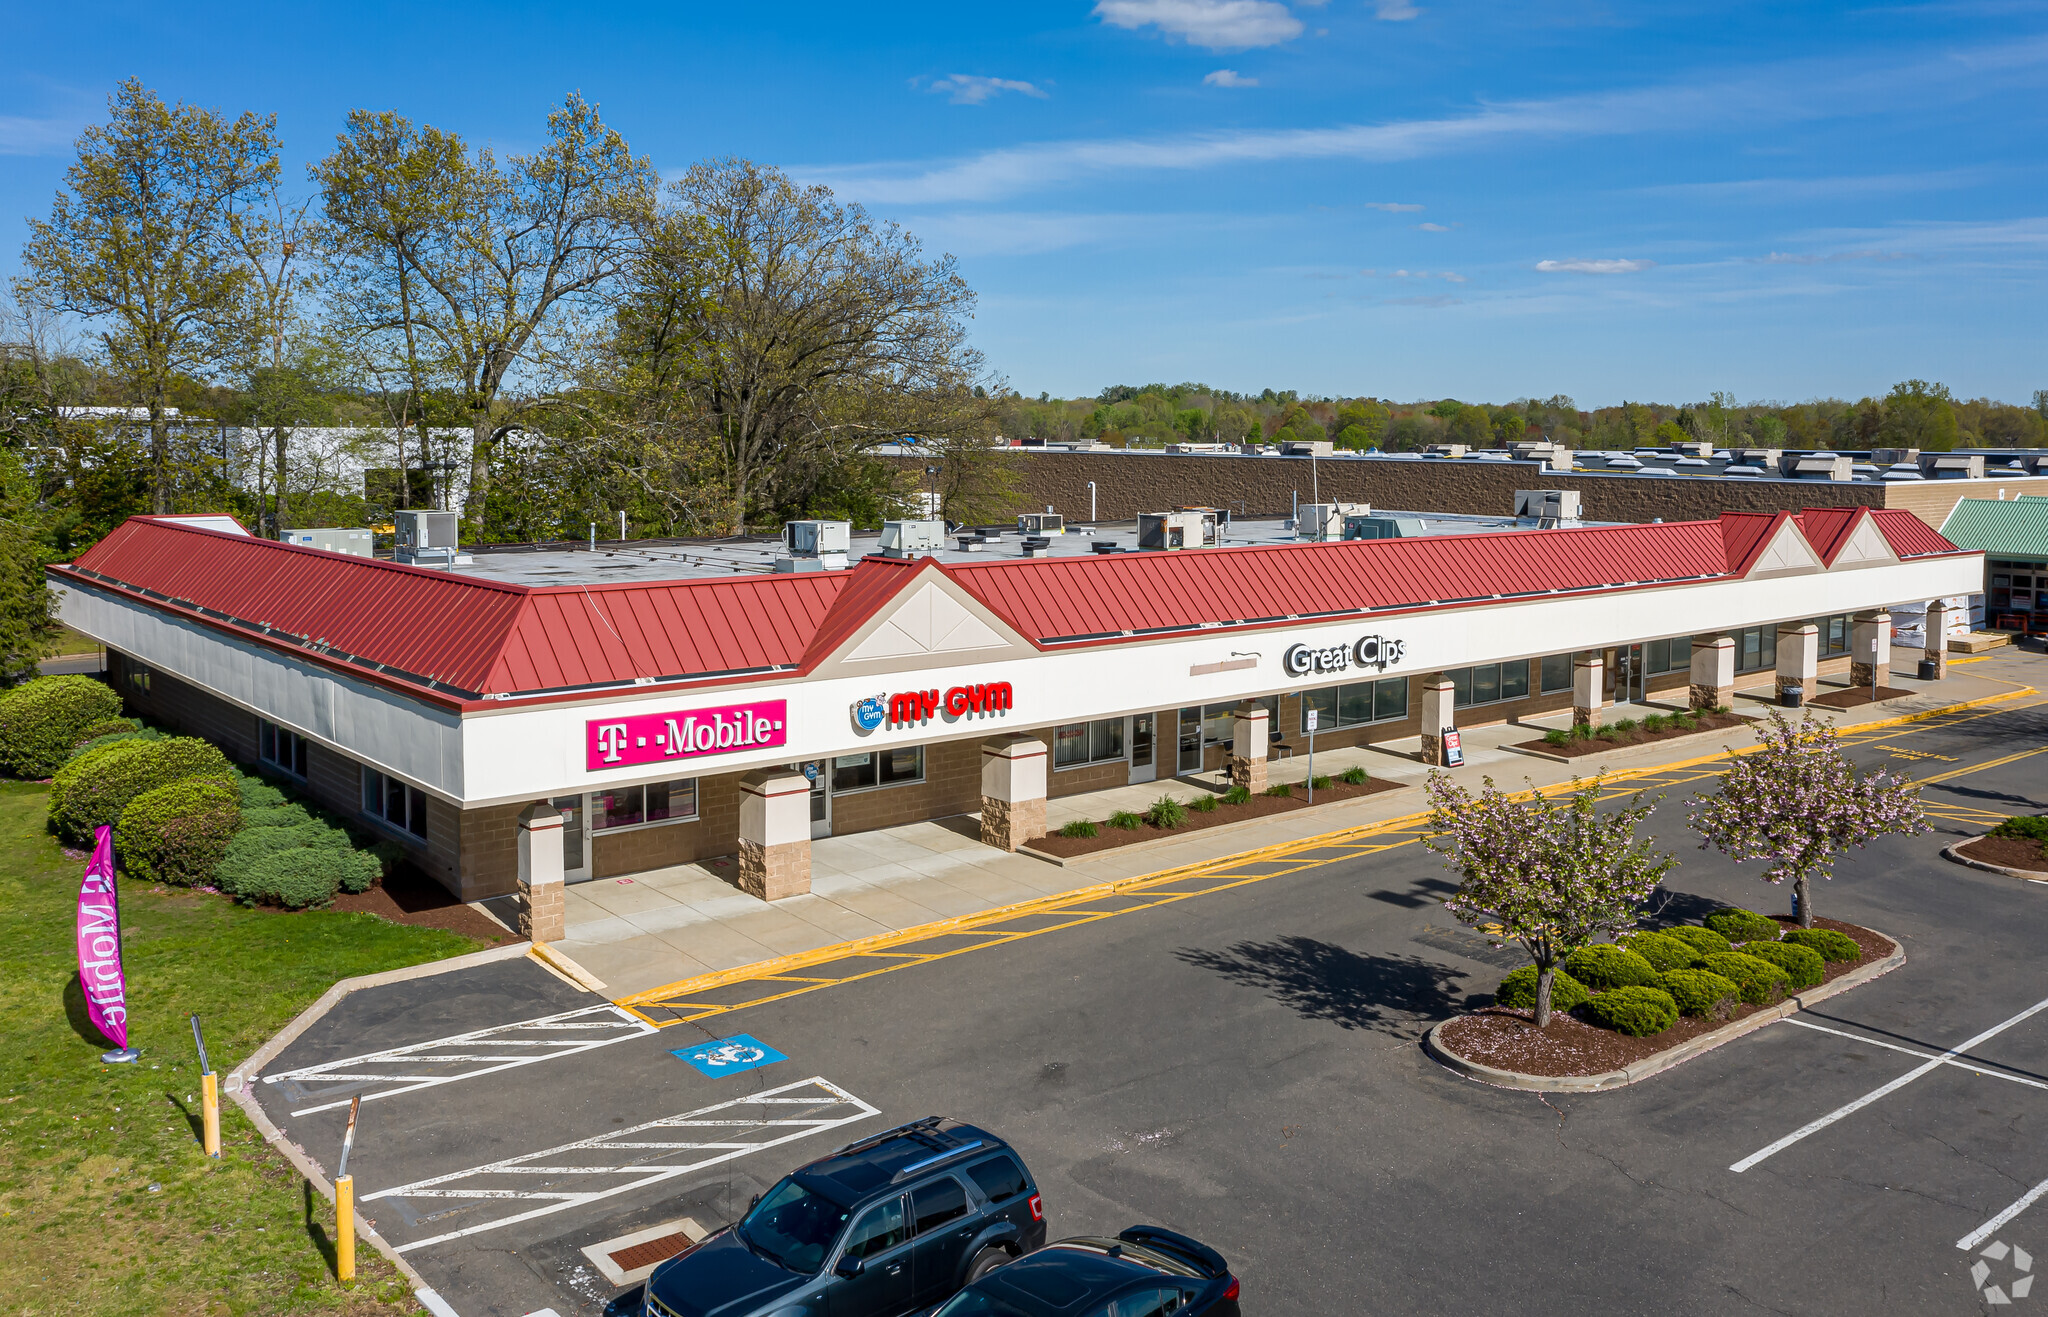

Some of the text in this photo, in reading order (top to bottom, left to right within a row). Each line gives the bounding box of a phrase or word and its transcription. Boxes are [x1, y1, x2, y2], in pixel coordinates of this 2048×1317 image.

[1285, 635, 1408, 674] Great Clips
[944, 681, 1013, 717] GYM
[863, 711, 881, 721] GYM
[1873, 744, 1960, 762] PARKING
